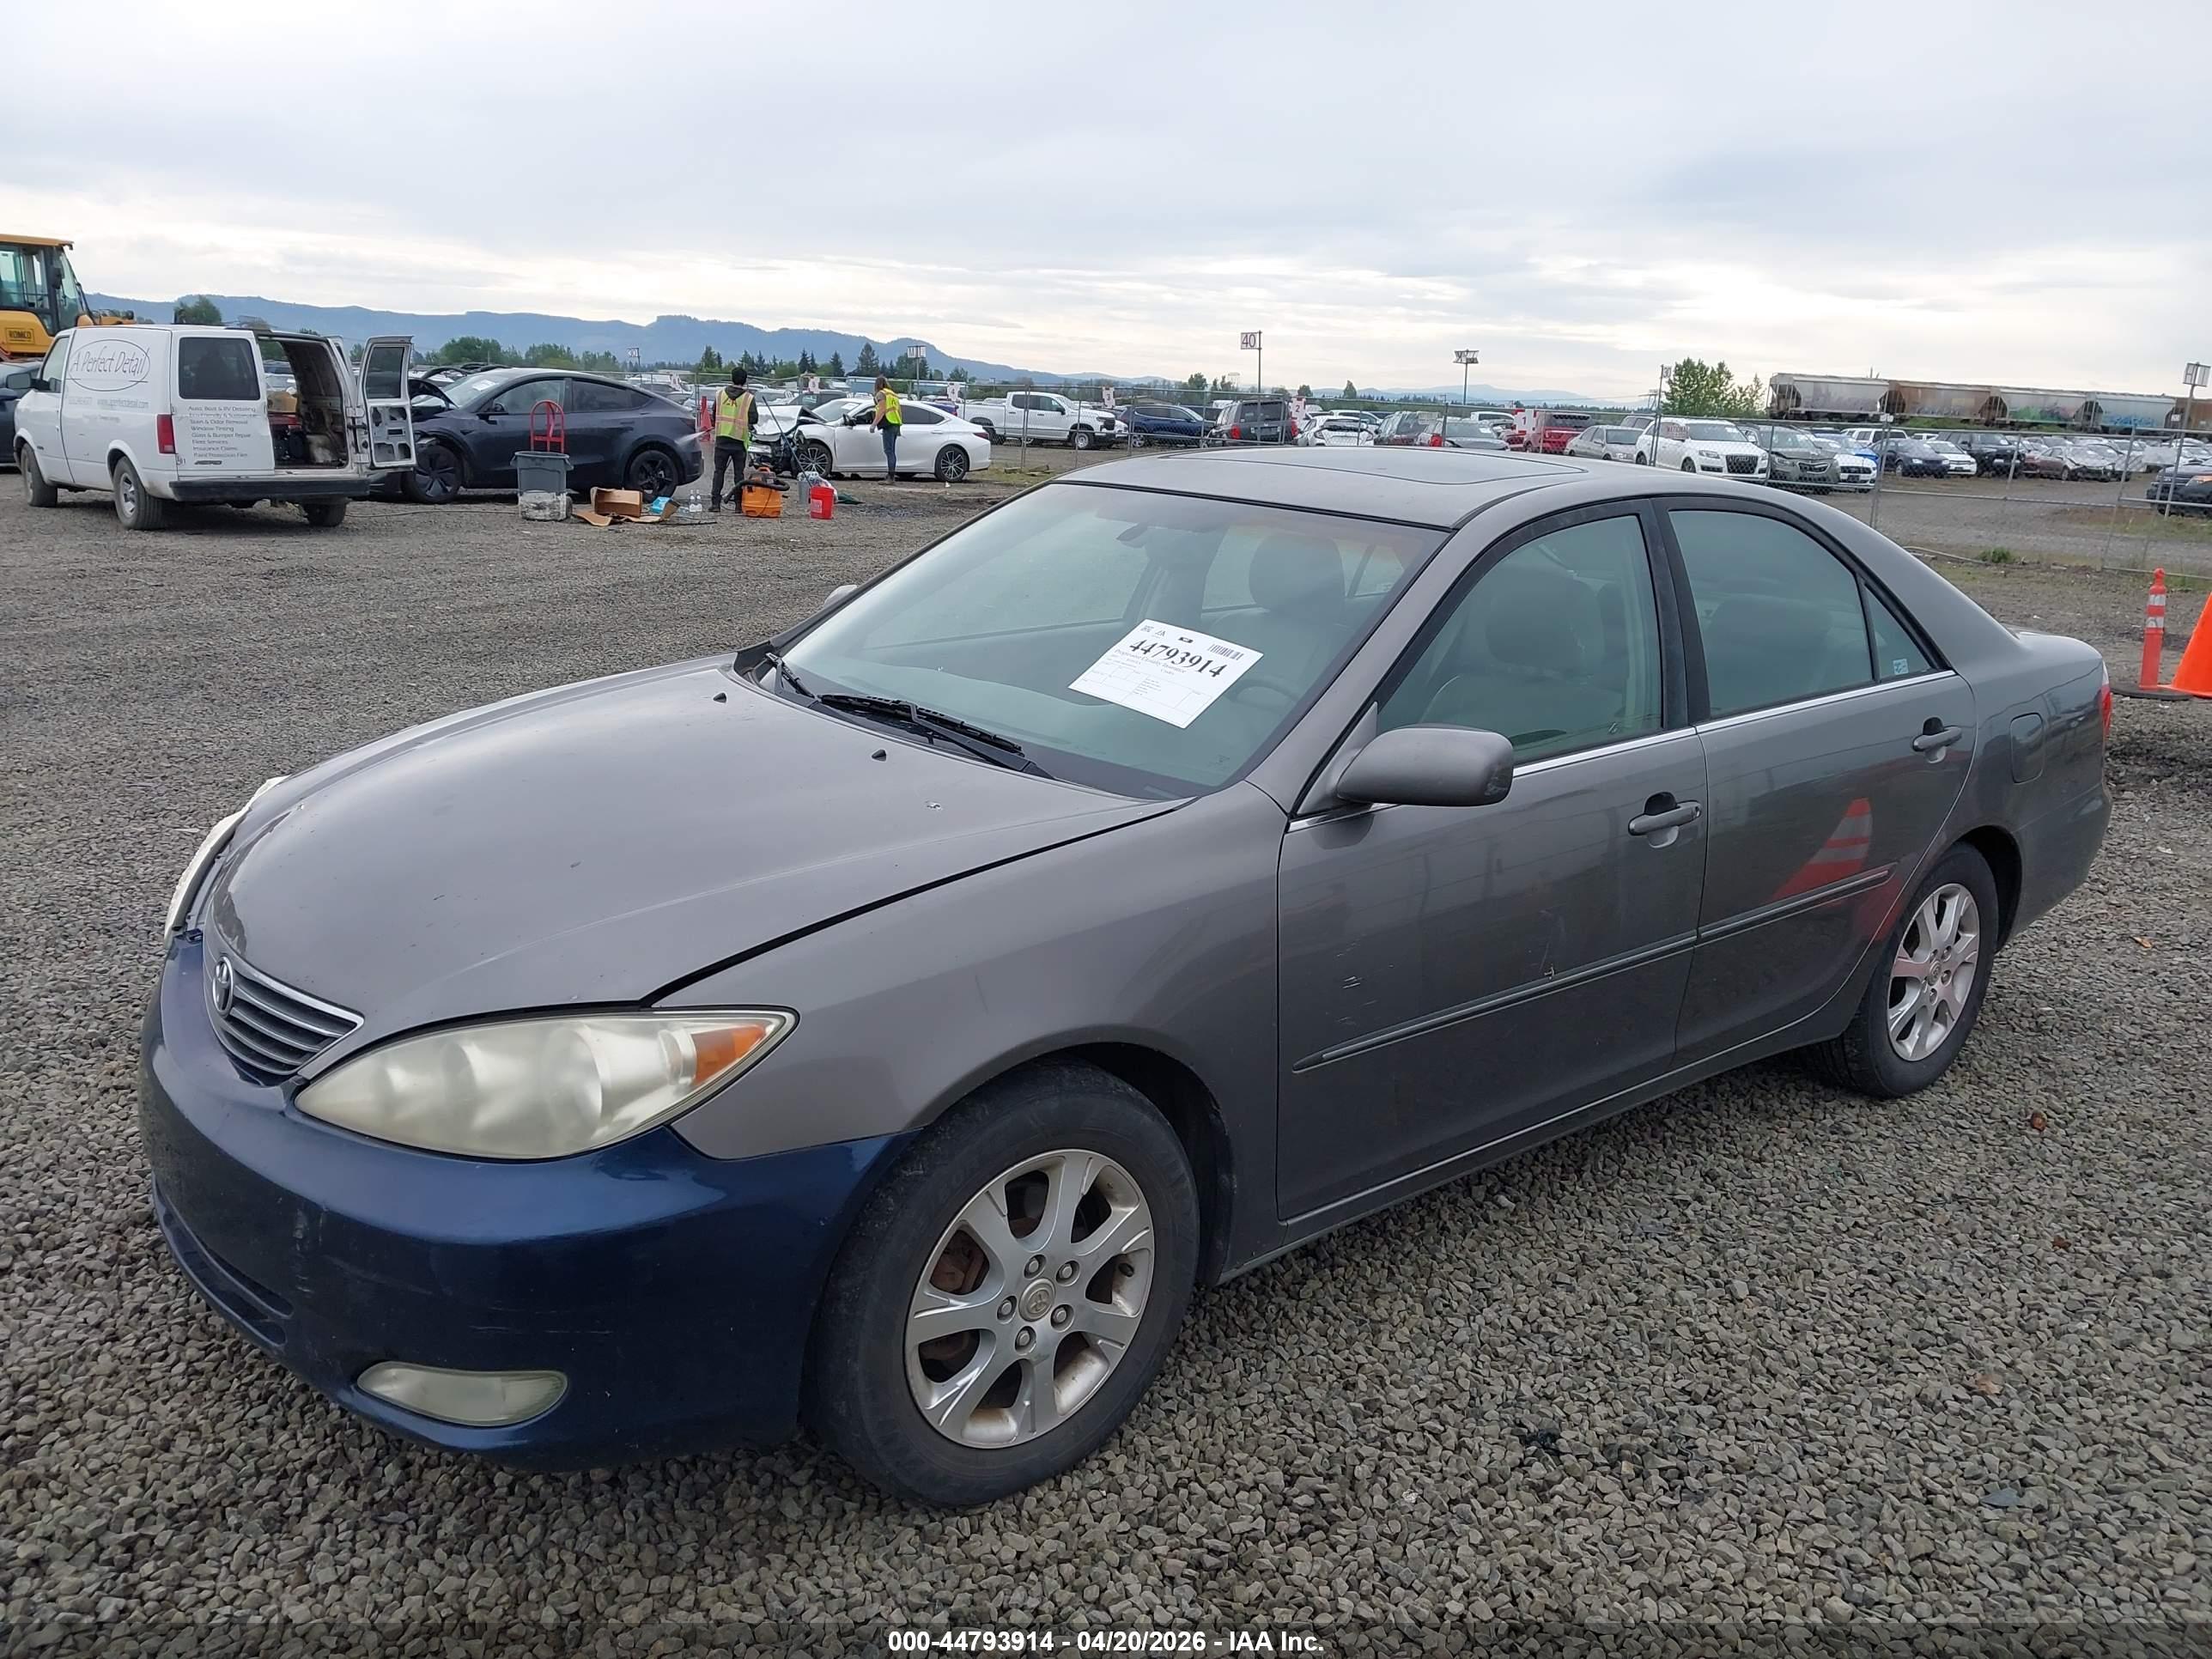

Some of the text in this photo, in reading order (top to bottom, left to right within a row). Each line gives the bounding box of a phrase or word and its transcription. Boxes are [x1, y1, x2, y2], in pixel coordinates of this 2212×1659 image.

[1242, 334, 1256, 348] 40
[70, 345, 150, 376] A Perfect Detail
[1129, 639, 1228, 678] 44793914
